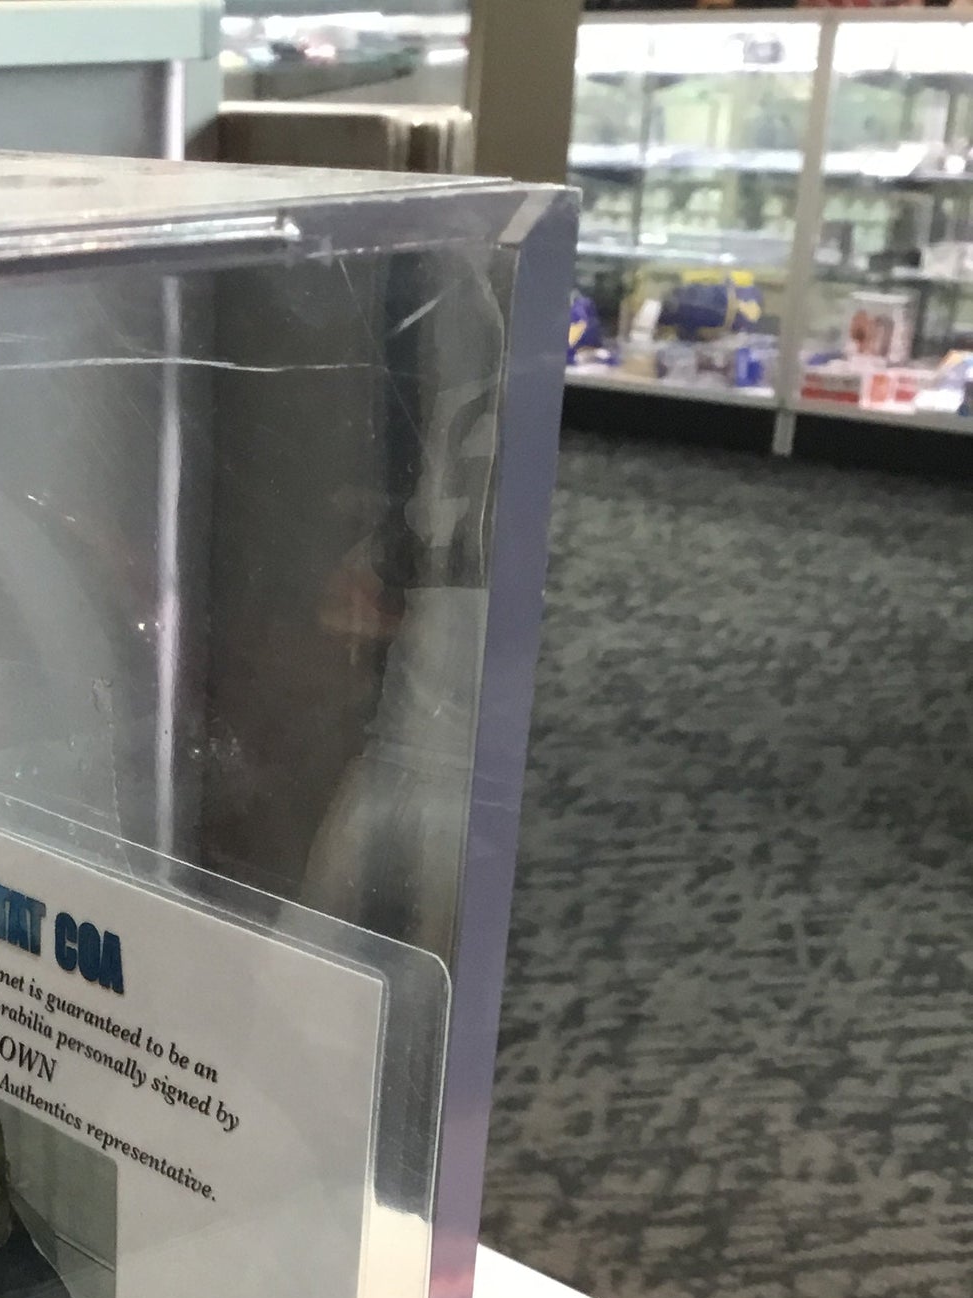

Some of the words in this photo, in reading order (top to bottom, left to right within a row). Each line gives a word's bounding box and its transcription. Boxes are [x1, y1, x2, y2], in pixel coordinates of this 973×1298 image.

[55, 911, 125, 995] COA
[29, 978, 43, 1001] is
[45, 992, 142, 1048] guaranteed
[146, 1035, 164, 1058] to
[169, 1042, 190, 1070] be
[194, 1062, 218, 1083] an
[56, 1031, 147, 1088] personally
[151, 1075, 211, 1116] signed
[216, 1101, 240, 1132] by
[86, 1122, 217, 1202] representative.
